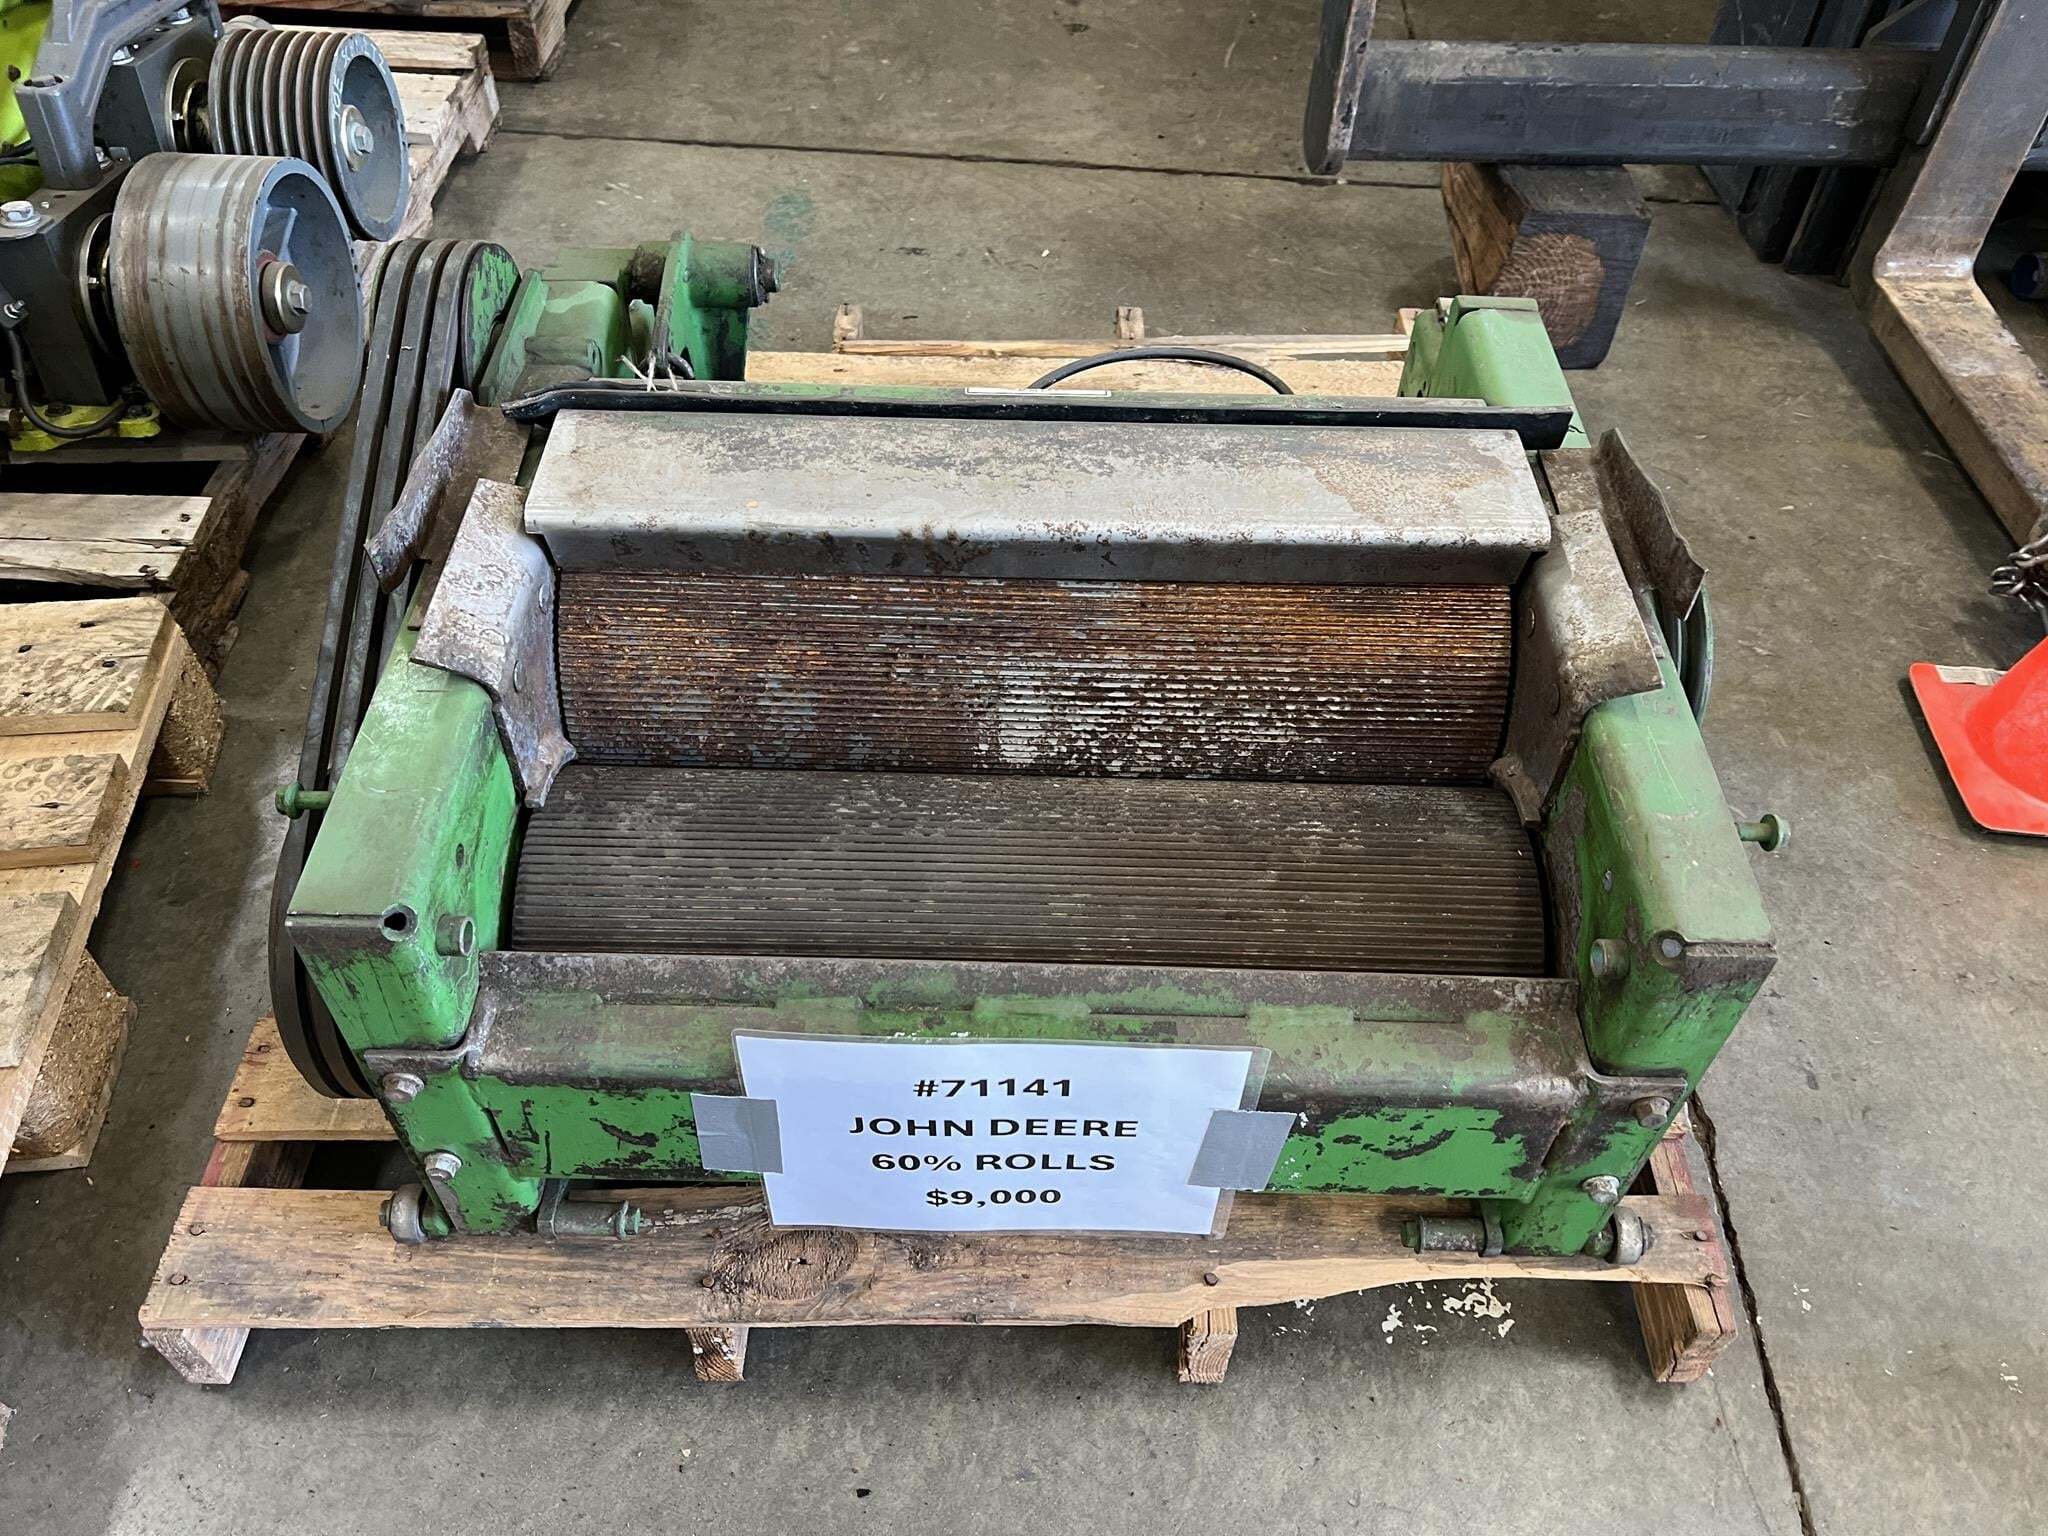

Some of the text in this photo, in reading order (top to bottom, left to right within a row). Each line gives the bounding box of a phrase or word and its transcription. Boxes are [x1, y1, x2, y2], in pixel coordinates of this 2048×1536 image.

[912, 1078, 1070, 1098] #71141
[849, 1117, 1139, 1138] JOHN DEERE
[871, 1153, 1115, 1172] 60% ROLLS
[925, 1188, 1062, 1208] $9,000
